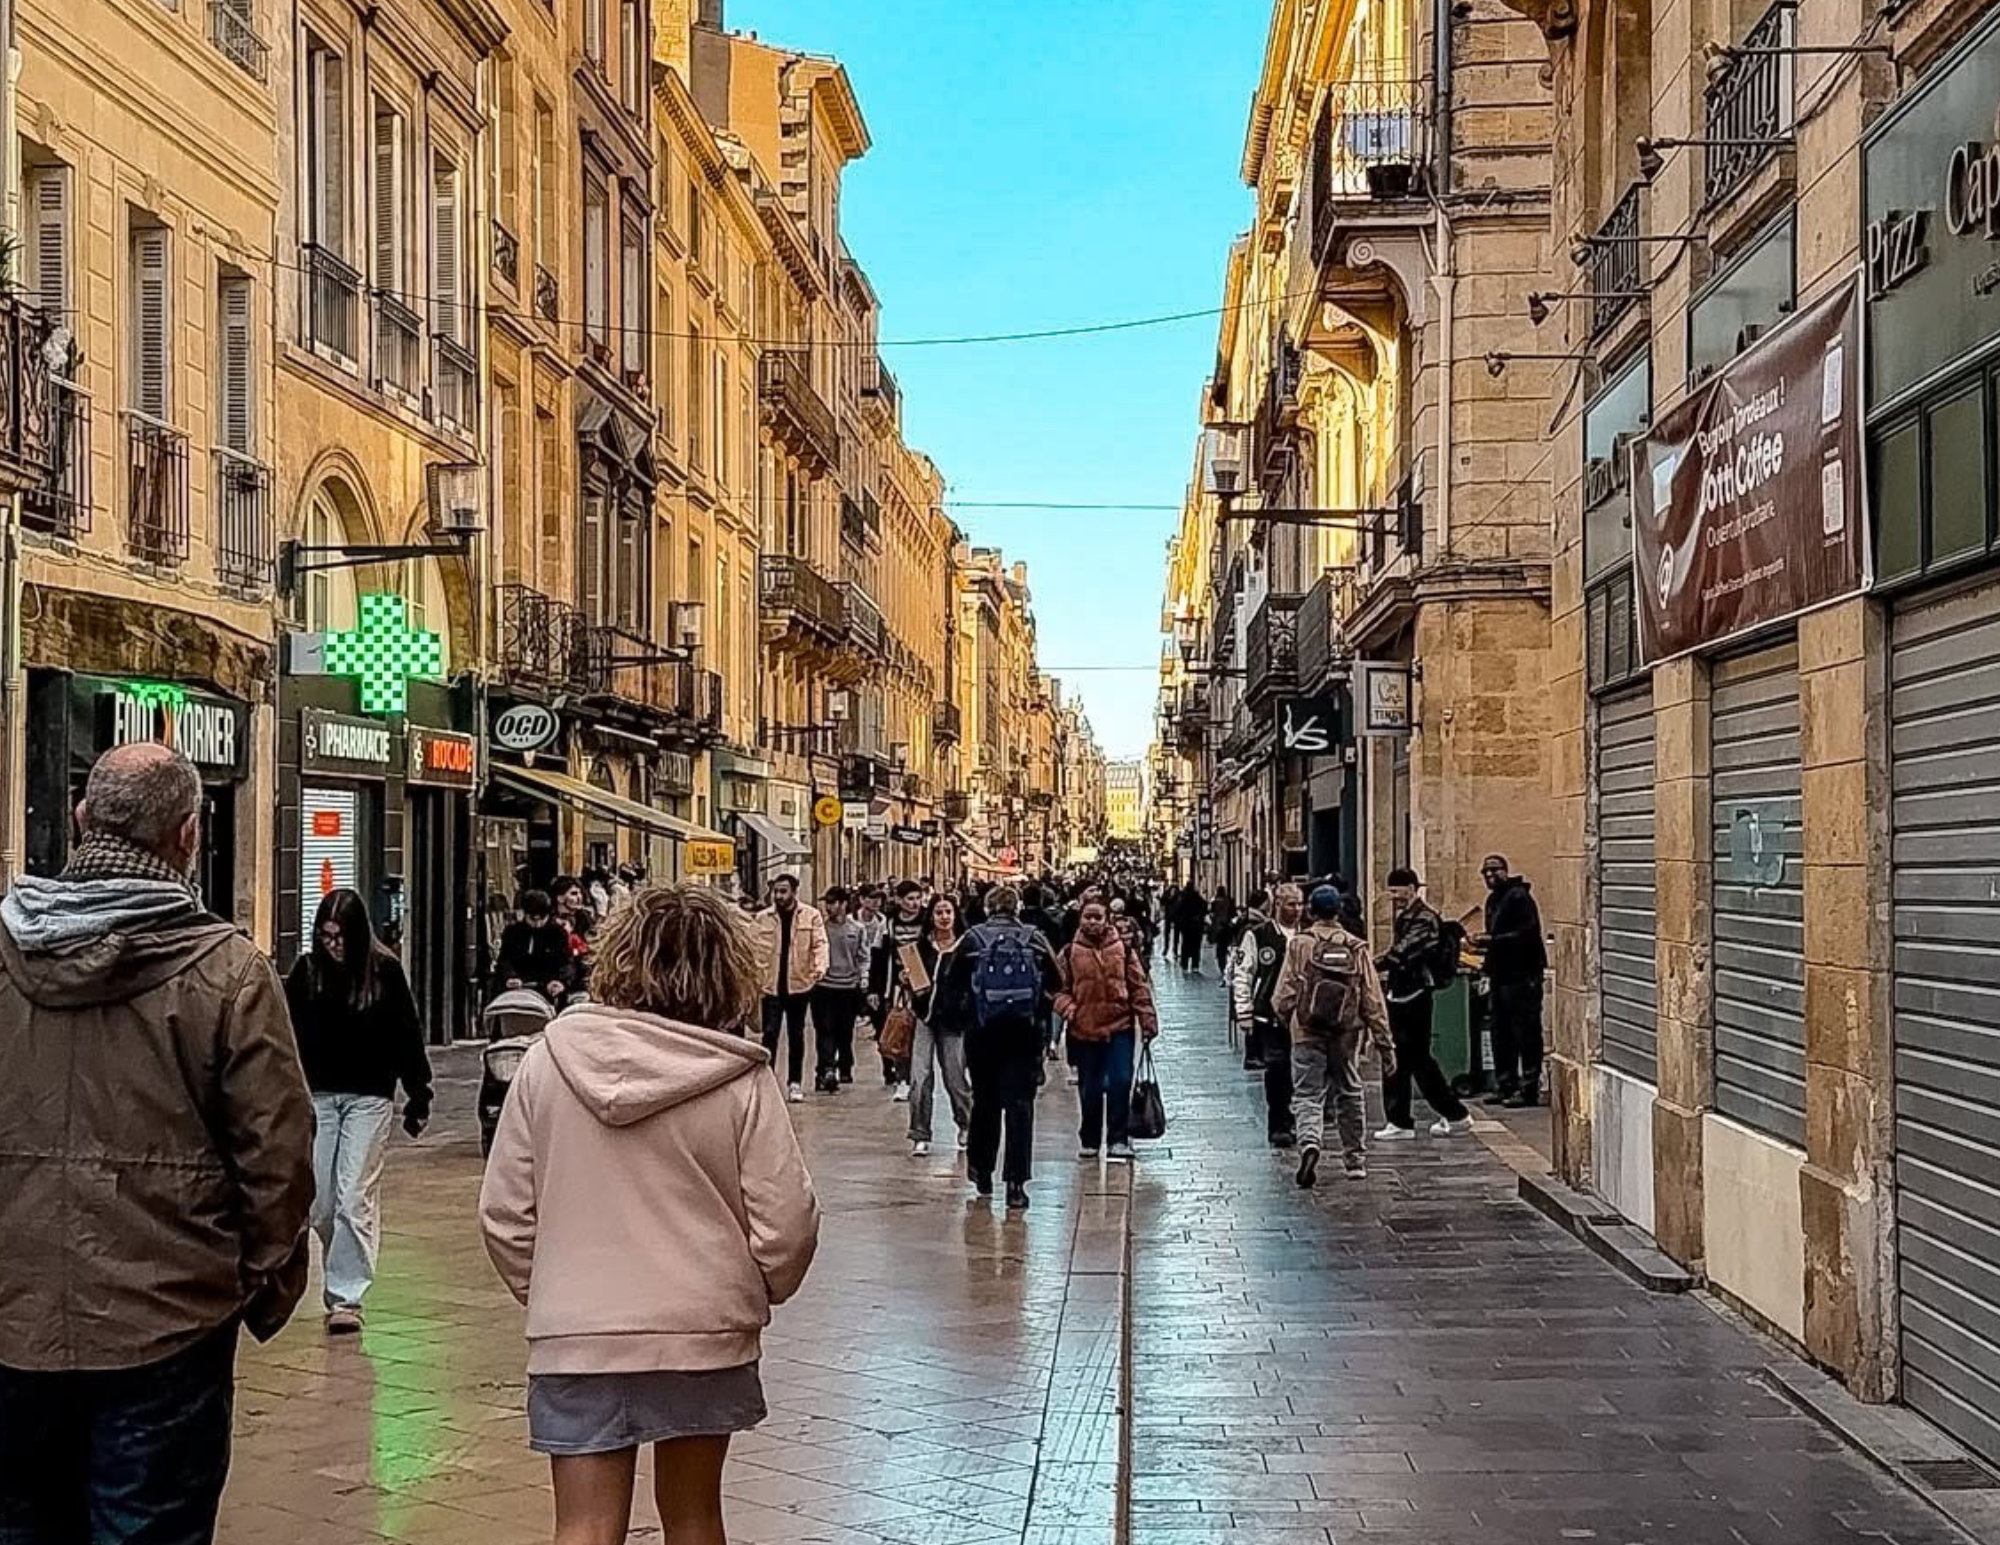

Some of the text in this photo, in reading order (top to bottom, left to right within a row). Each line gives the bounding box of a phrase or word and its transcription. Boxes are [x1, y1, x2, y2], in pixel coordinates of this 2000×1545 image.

[1734, 431, 1783, 496] Coffee
[113, 691, 235, 766] FOOT KORNER
[325, 722, 390, 763] PHARMACIE
[499, 715, 548, 736] OCD
